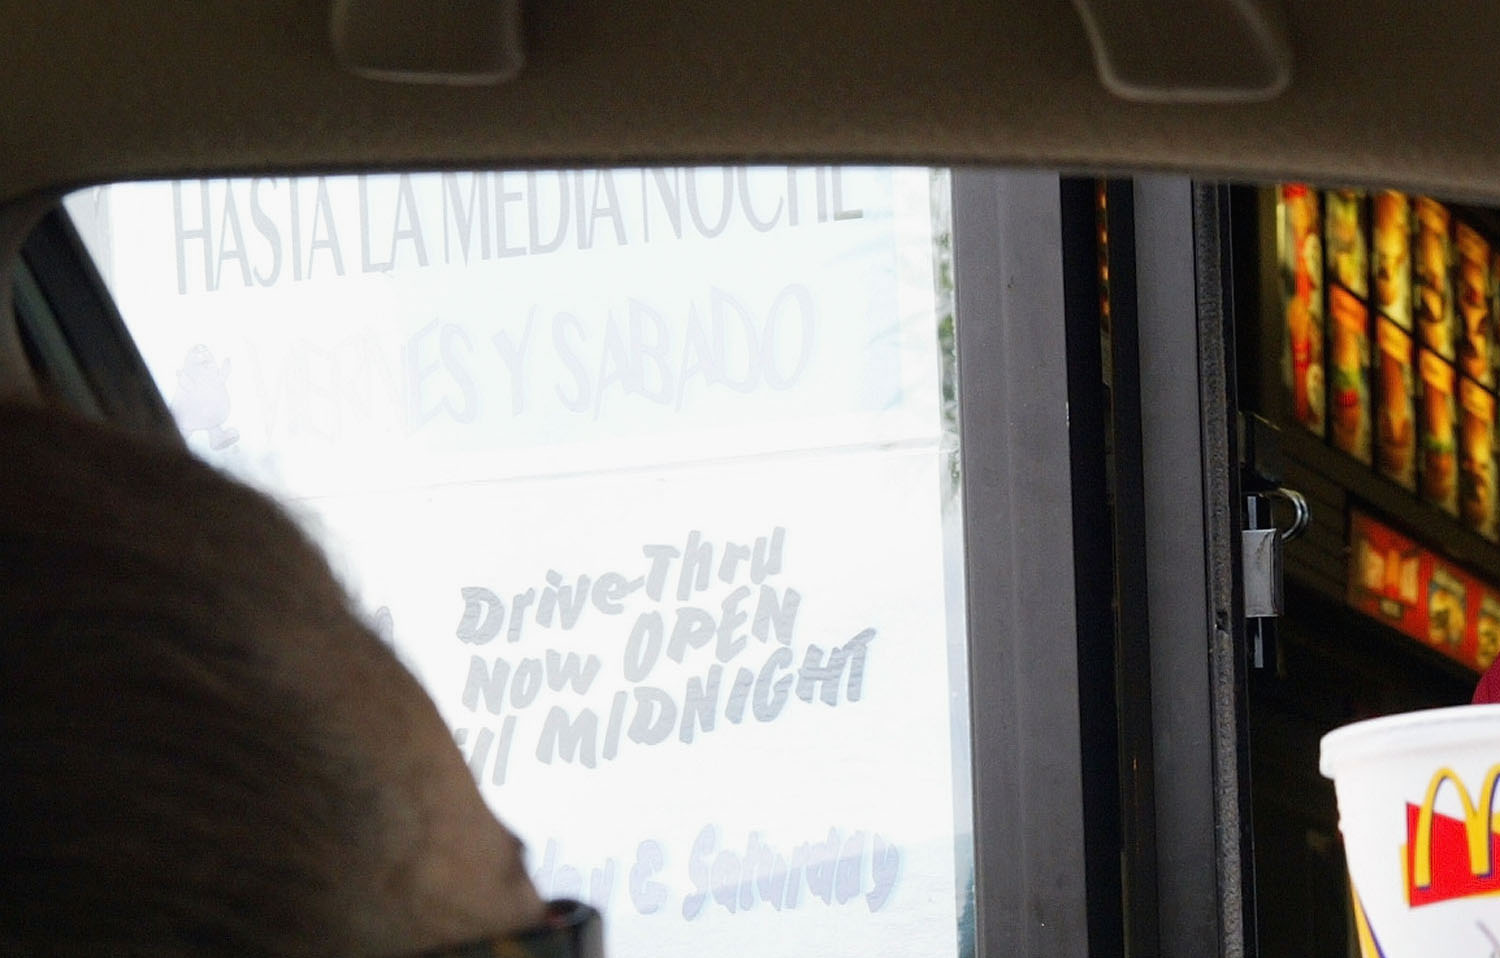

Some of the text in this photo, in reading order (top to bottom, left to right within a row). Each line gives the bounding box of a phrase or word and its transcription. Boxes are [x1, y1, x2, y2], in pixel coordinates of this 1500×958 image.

[357, 177, 430, 274] LA
[623, 583, 802, 684] OPEN
[536, 626, 878, 769] MIDNIGHT
